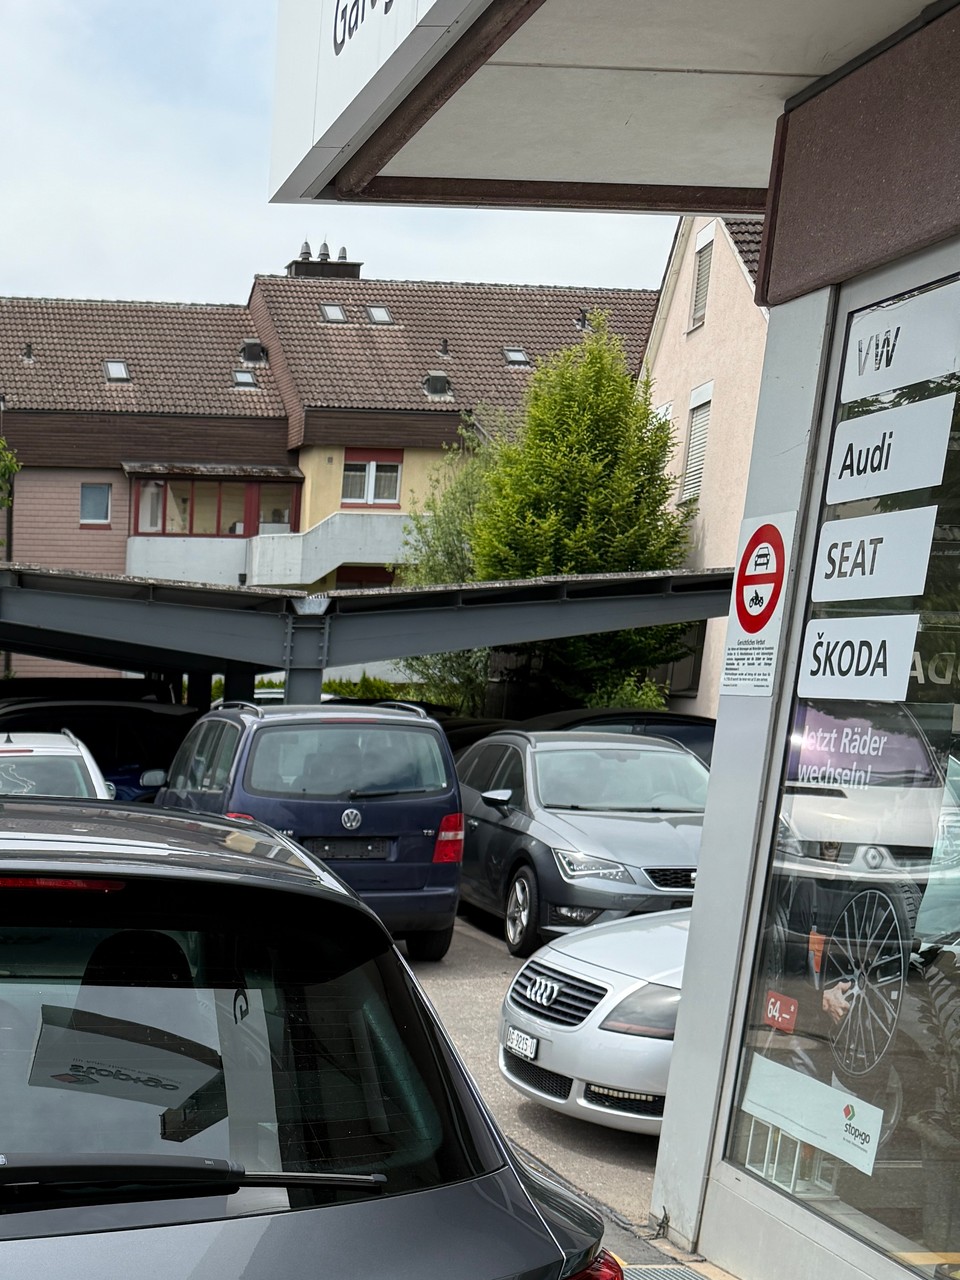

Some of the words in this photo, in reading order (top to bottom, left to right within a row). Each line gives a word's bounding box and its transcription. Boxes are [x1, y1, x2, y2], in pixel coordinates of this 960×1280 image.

[333, 0, 394, 56] Gar
[858, 326, 901, 377] VW
[838, 431, 893, 480] Audi
[824, 537, 884, 580] SEAT
[810, 632, 888, 677] ŠKODA
[801, 725, 838, 753] Jetzt
[840, 727, 888, 756] Räder
[798, 759, 872, 790] wechseln!
[844, 1122, 871, 1145] stop+go
